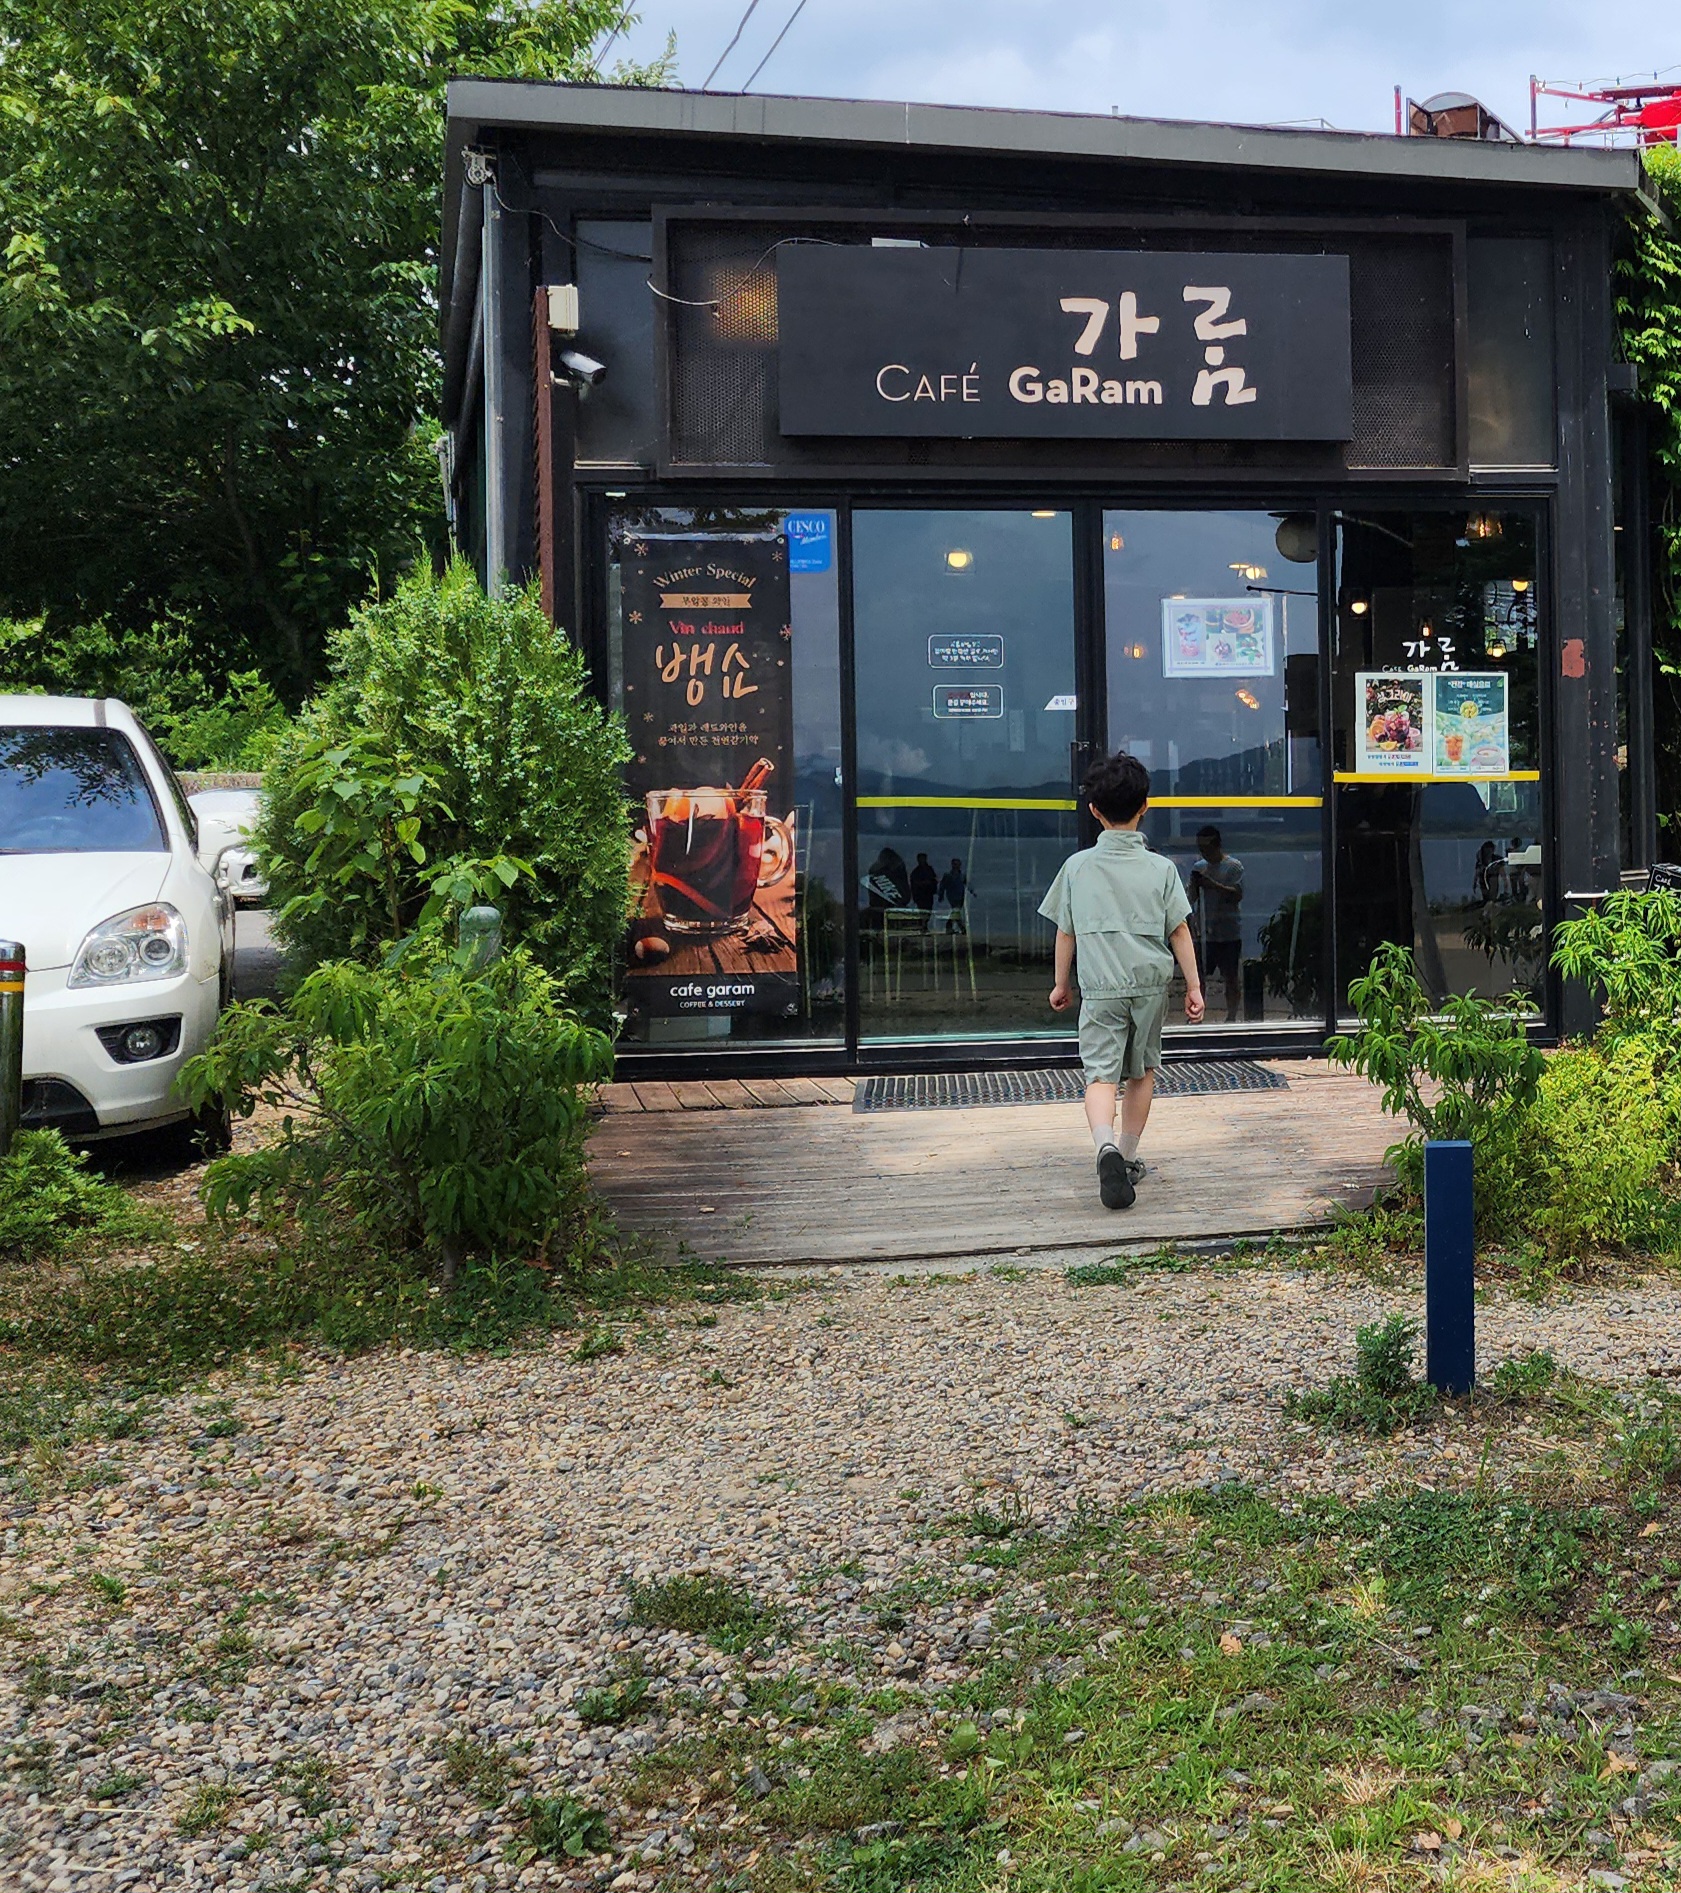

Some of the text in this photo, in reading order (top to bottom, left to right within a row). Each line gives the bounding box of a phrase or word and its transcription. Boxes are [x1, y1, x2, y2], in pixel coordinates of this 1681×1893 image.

[1059, 285, 1257, 406] 가람
[1008, 366, 1162, 404] GaRam
[788, 520, 825, 533] CESCO
[653, 562, 757, 589] Winter Special
[668, 620, 744, 635] Vin chaud
[670, 983, 755, 998] cafe garam
